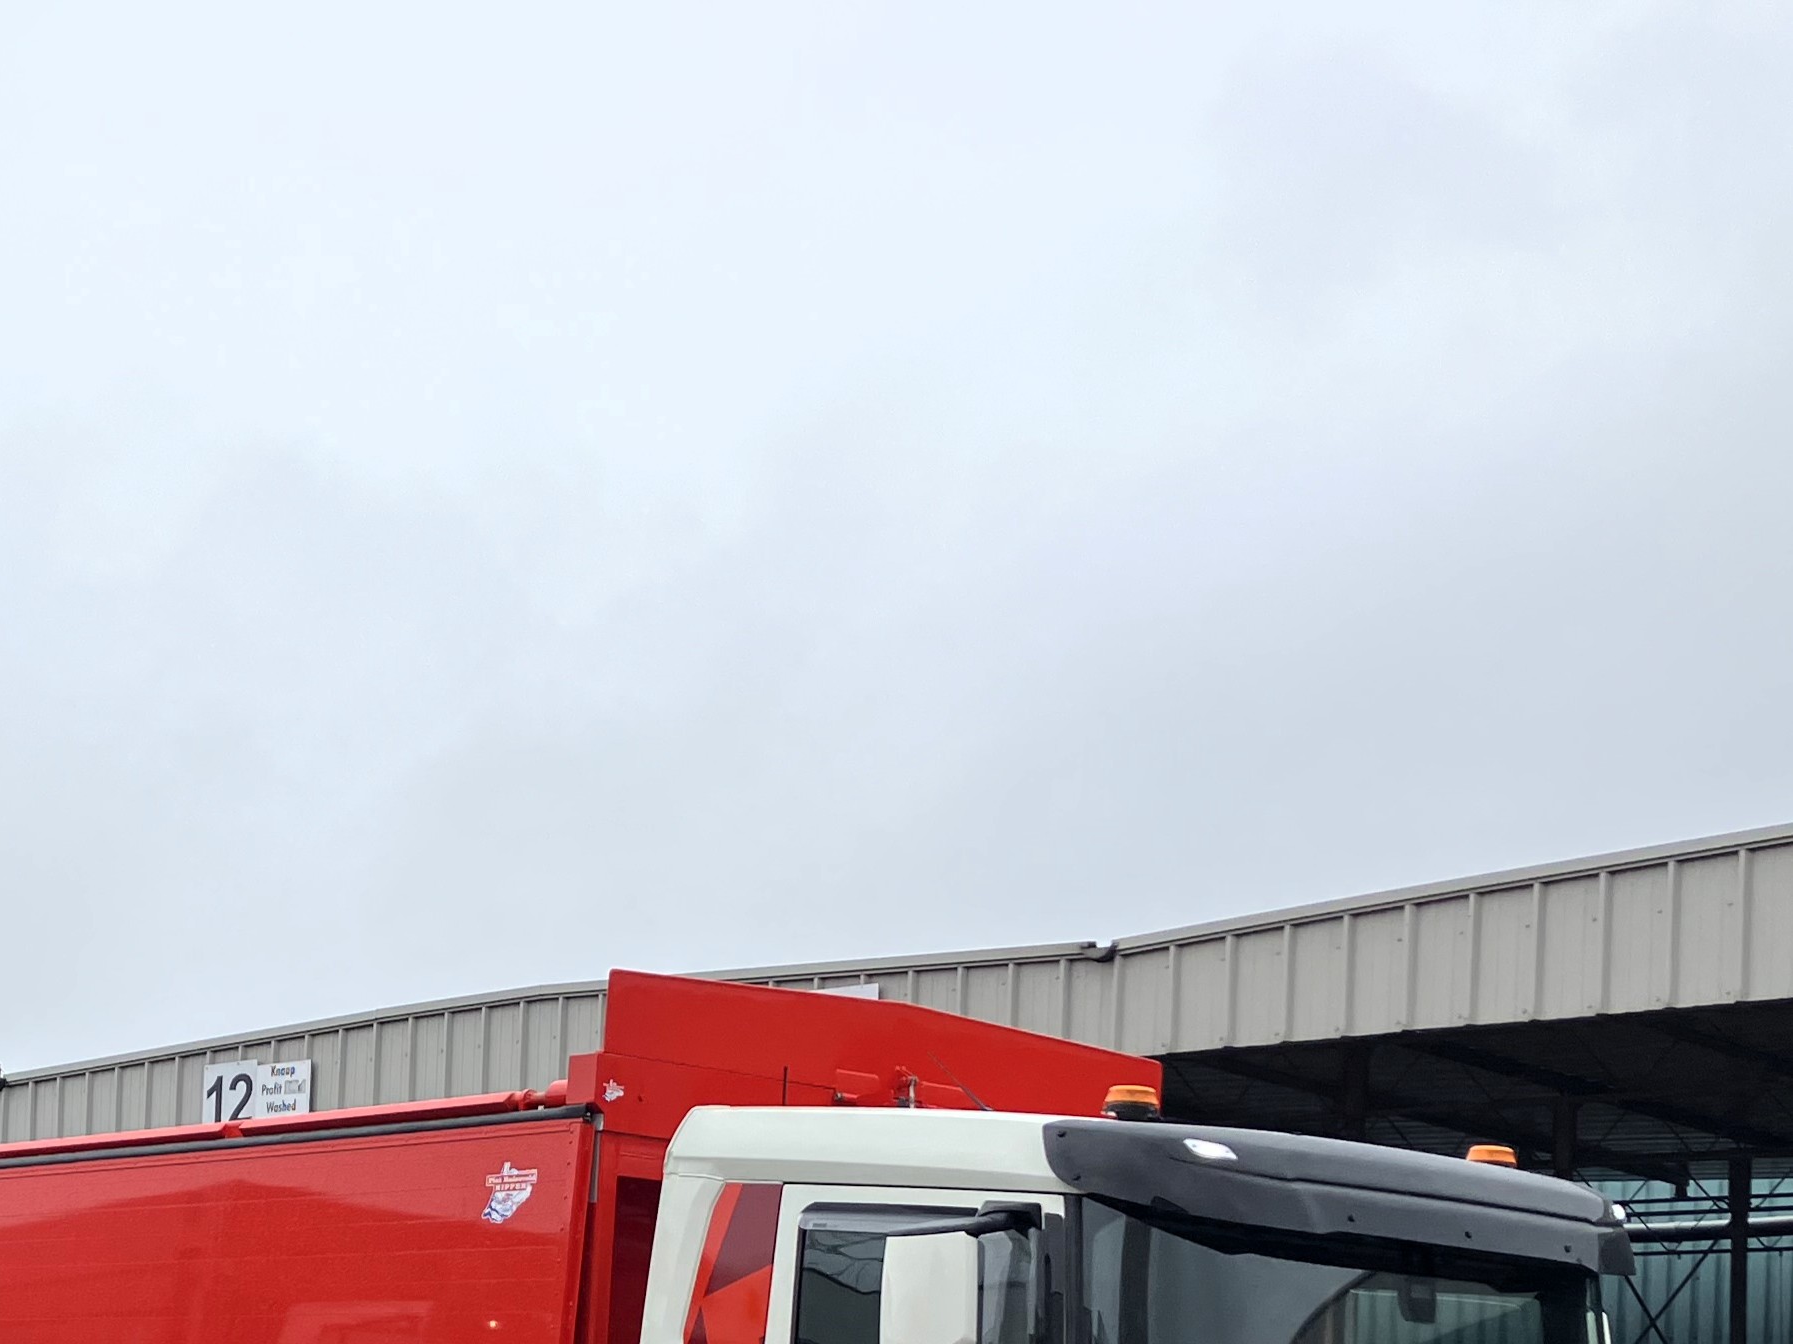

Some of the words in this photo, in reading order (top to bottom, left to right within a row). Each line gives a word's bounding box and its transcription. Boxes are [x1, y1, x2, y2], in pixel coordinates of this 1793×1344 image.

[262, 1082, 282, 1096] Profit
[207, 1073, 253, 1122] 12
[267, 1099, 296, 1113] Washed
